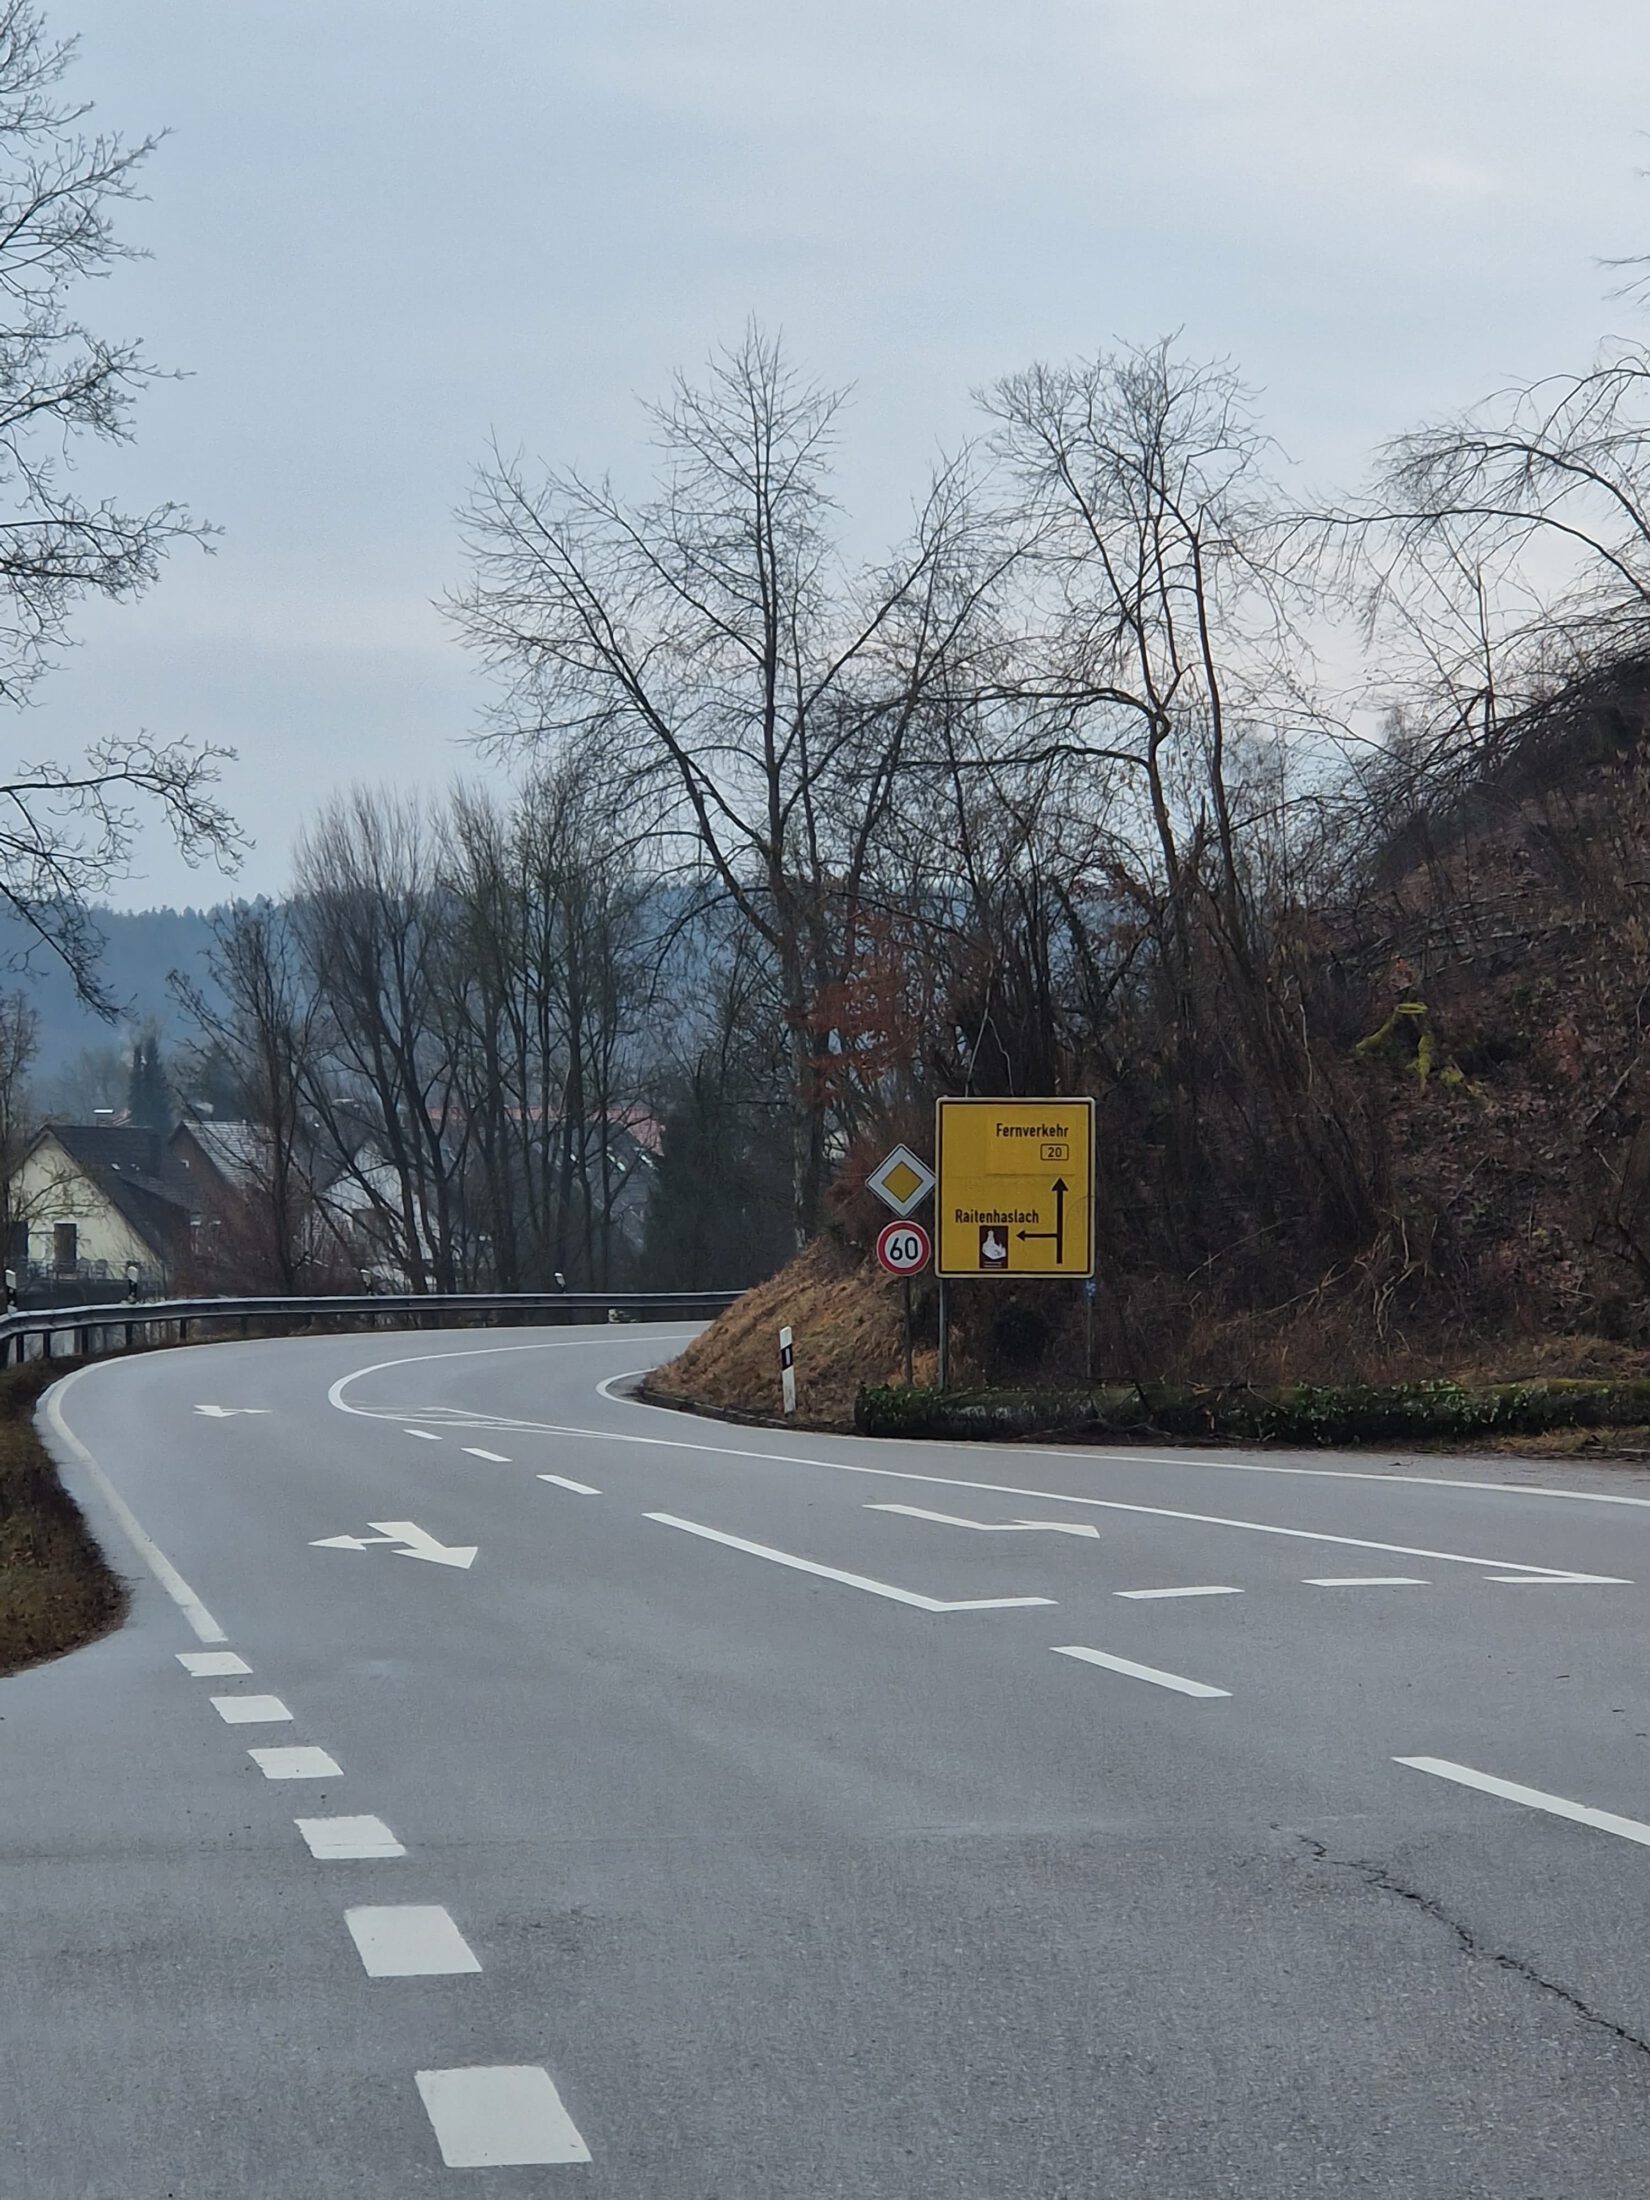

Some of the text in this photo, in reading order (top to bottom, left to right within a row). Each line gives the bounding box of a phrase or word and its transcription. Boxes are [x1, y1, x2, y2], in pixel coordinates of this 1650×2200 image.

[996, 1123, 1069, 1138] Fernverkehr
[1047, 1147, 1062, 1158] 20
[955, 1208, 1039, 1223] Raitenhaslach
[889, 1236, 919, 1261] 60
